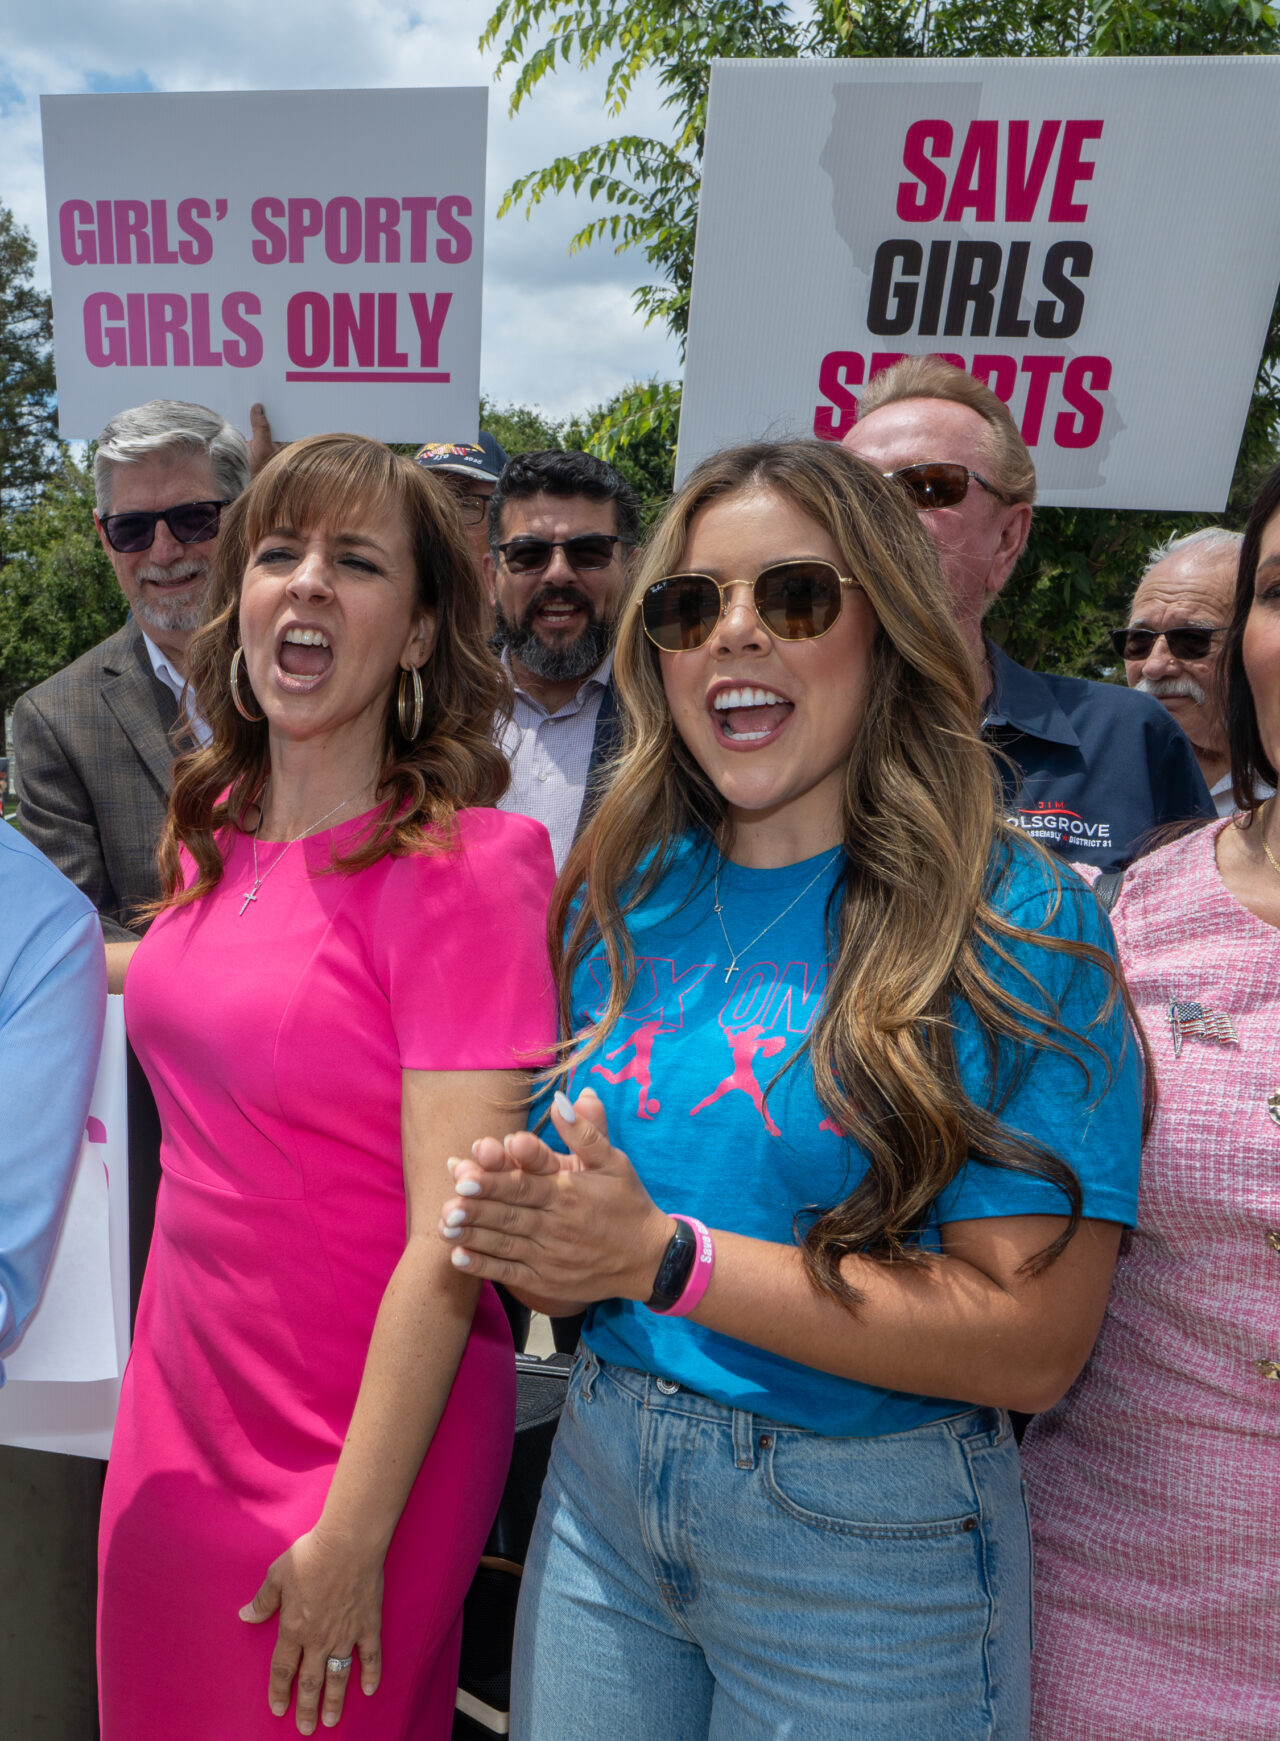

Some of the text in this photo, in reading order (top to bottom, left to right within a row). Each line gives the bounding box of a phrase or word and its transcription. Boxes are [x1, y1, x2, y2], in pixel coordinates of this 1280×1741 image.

[896, 119, 1104, 222] SAVE
[251, 195, 473, 264] SPORTS
[866, 239, 1093, 338] GIRLS
[83, 291, 453, 369] GIRLS ONLY
[814, 351, 1112, 448] SRTS
[1006, 815, 1110, 837] OLSGROVE
[1038, 801, 1065, 809] JIM
[1102, 840, 1112, 848] 31
[719, 961, 836, 1033] ON
